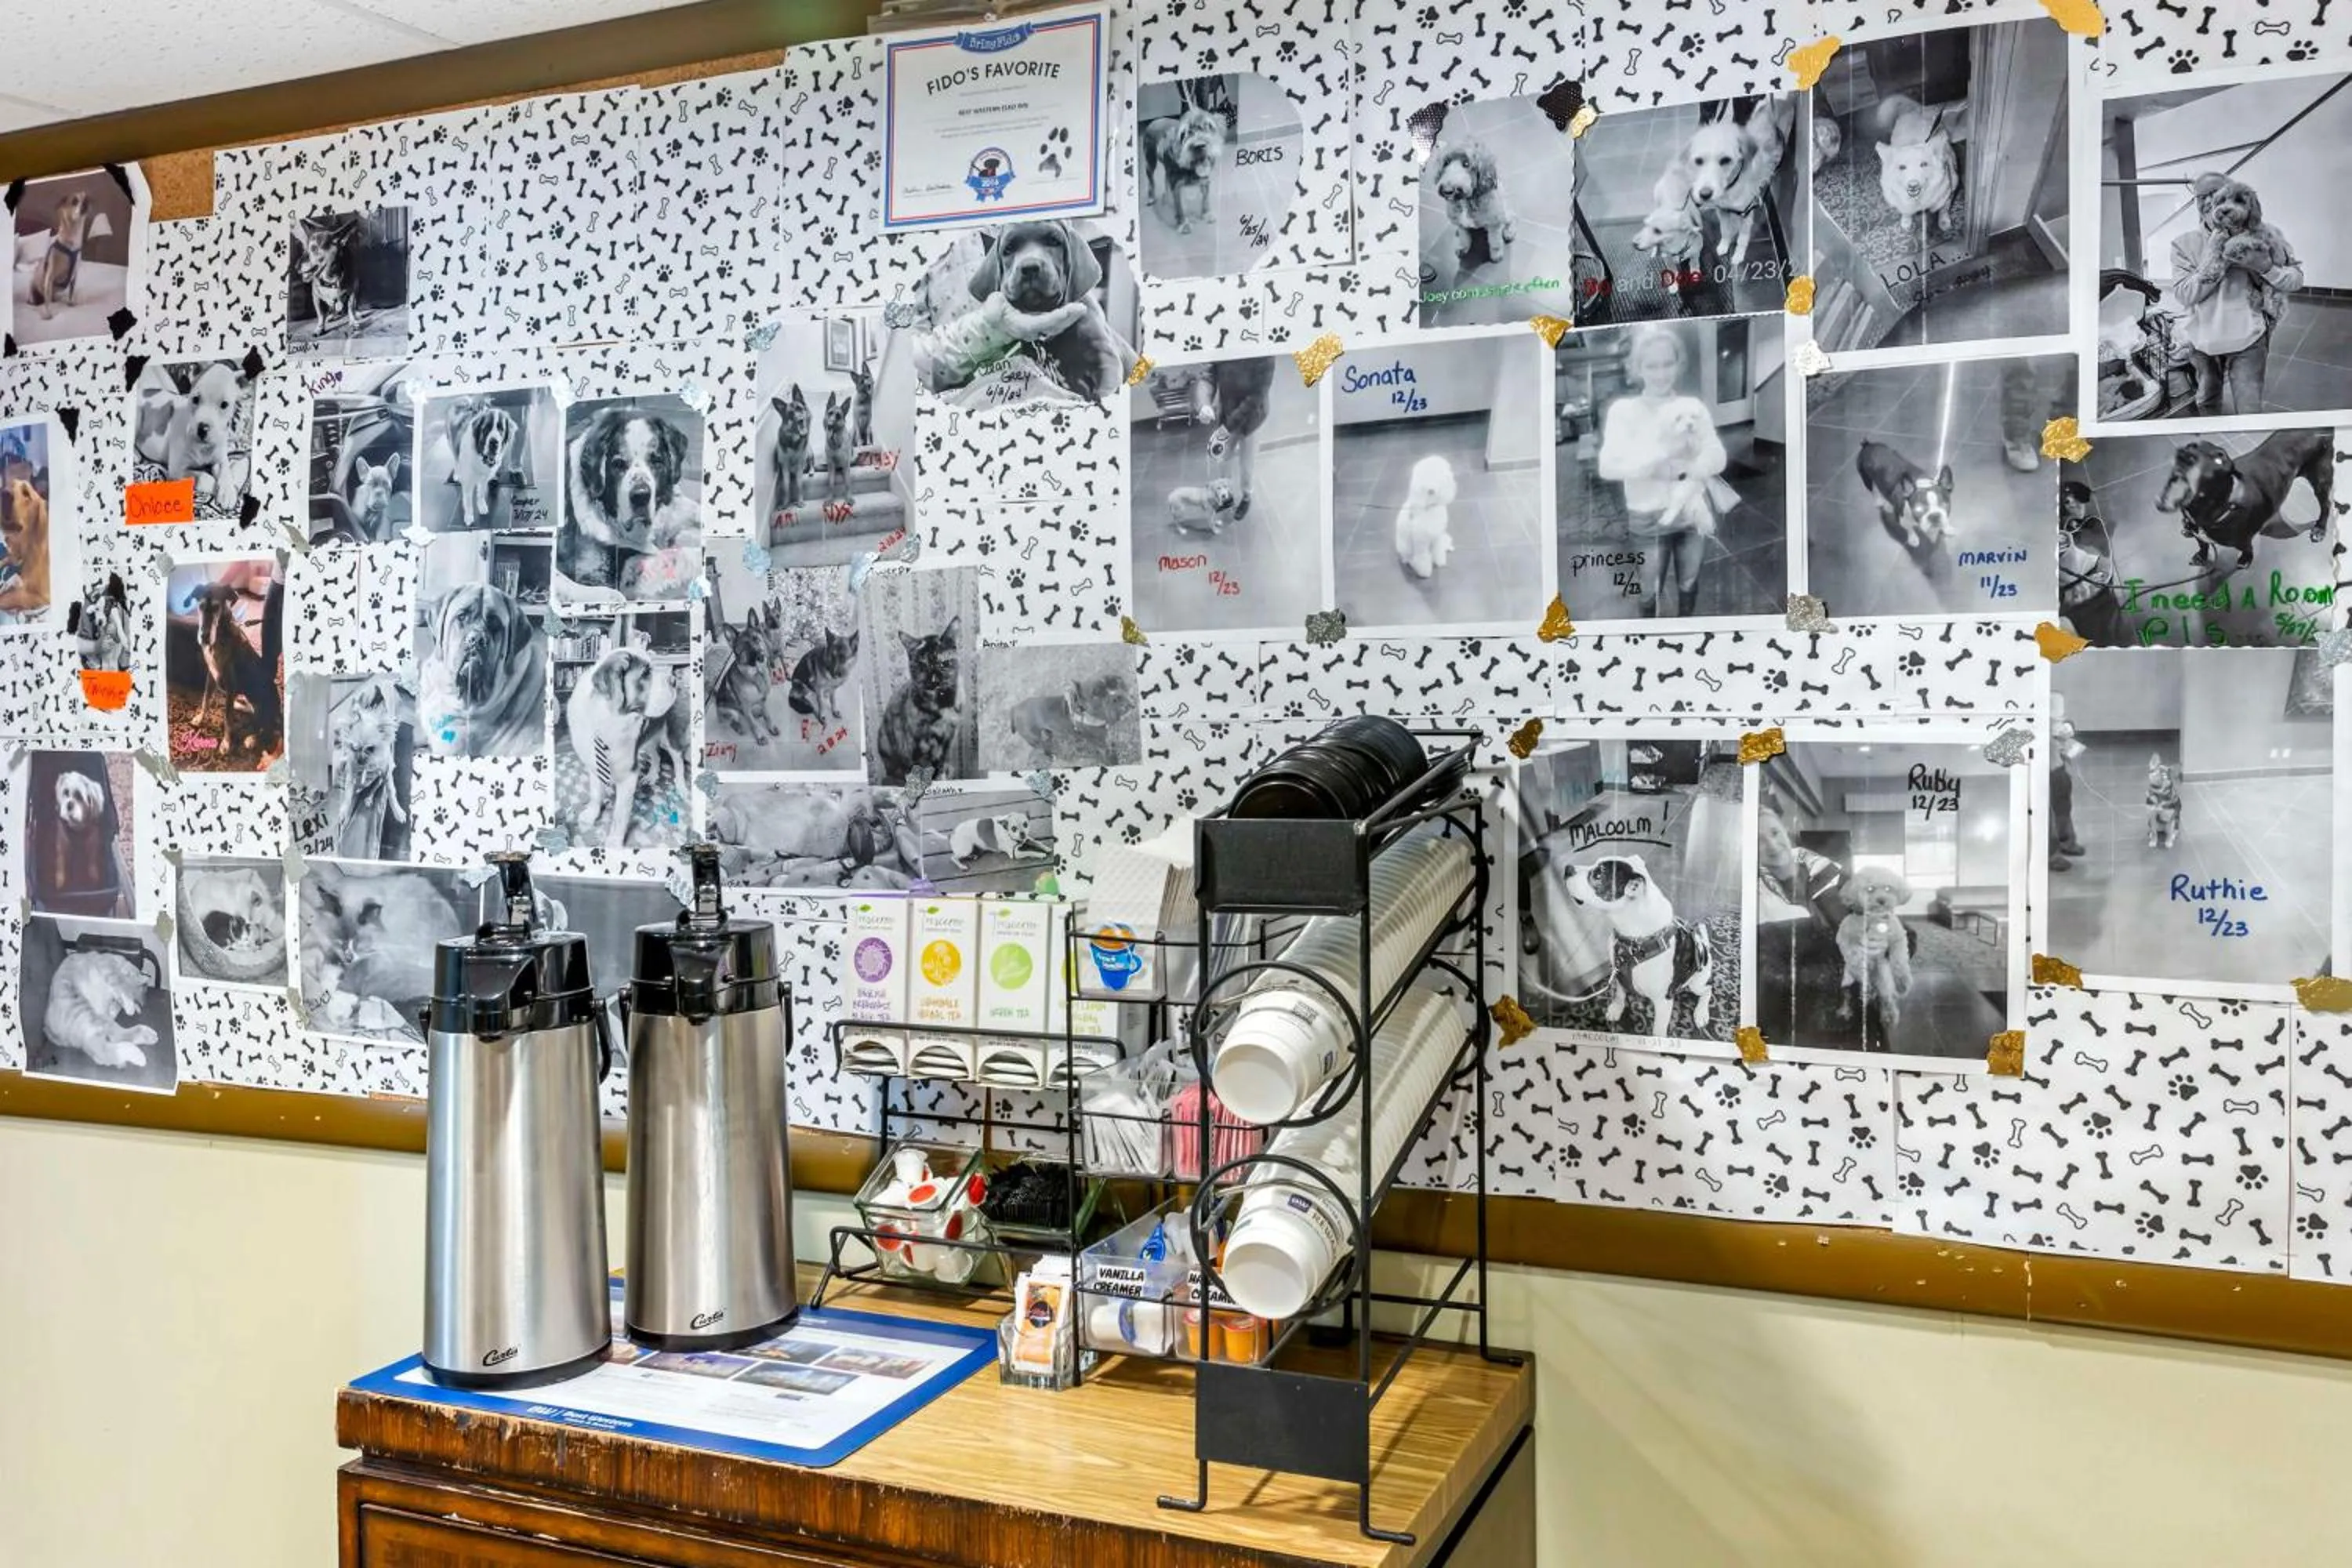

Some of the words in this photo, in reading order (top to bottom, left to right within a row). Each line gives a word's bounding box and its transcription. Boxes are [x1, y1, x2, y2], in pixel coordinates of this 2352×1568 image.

[926, 66, 980, 96] FIDO'S
[985, 60, 1061, 79] FAVORITE
[1236, 147, 1283, 166] BORIS
[1341, 360, 1417, 393] Sonata
[1392, 388, 1428, 413] 12/23
[1208, 571, 1241, 596] 12/23
[1613, 571, 1642, 598] 12/23
[2151, 582, 2231, 613] need
[2269, 569, 2335, 608] Room
[1907, 762, 1961, 799] Ruby
[1911, 793, 1959, 821] 12/23
[292, 808, 328, 843] Lexi
[2170, 873, 2269, 902] Ruthie
[2198, 907, 2249, 937] 12/23
[1098, 1267, 1145, 1282] VANILLA
[1093, 1282, 1143, 1296] CREAMER
